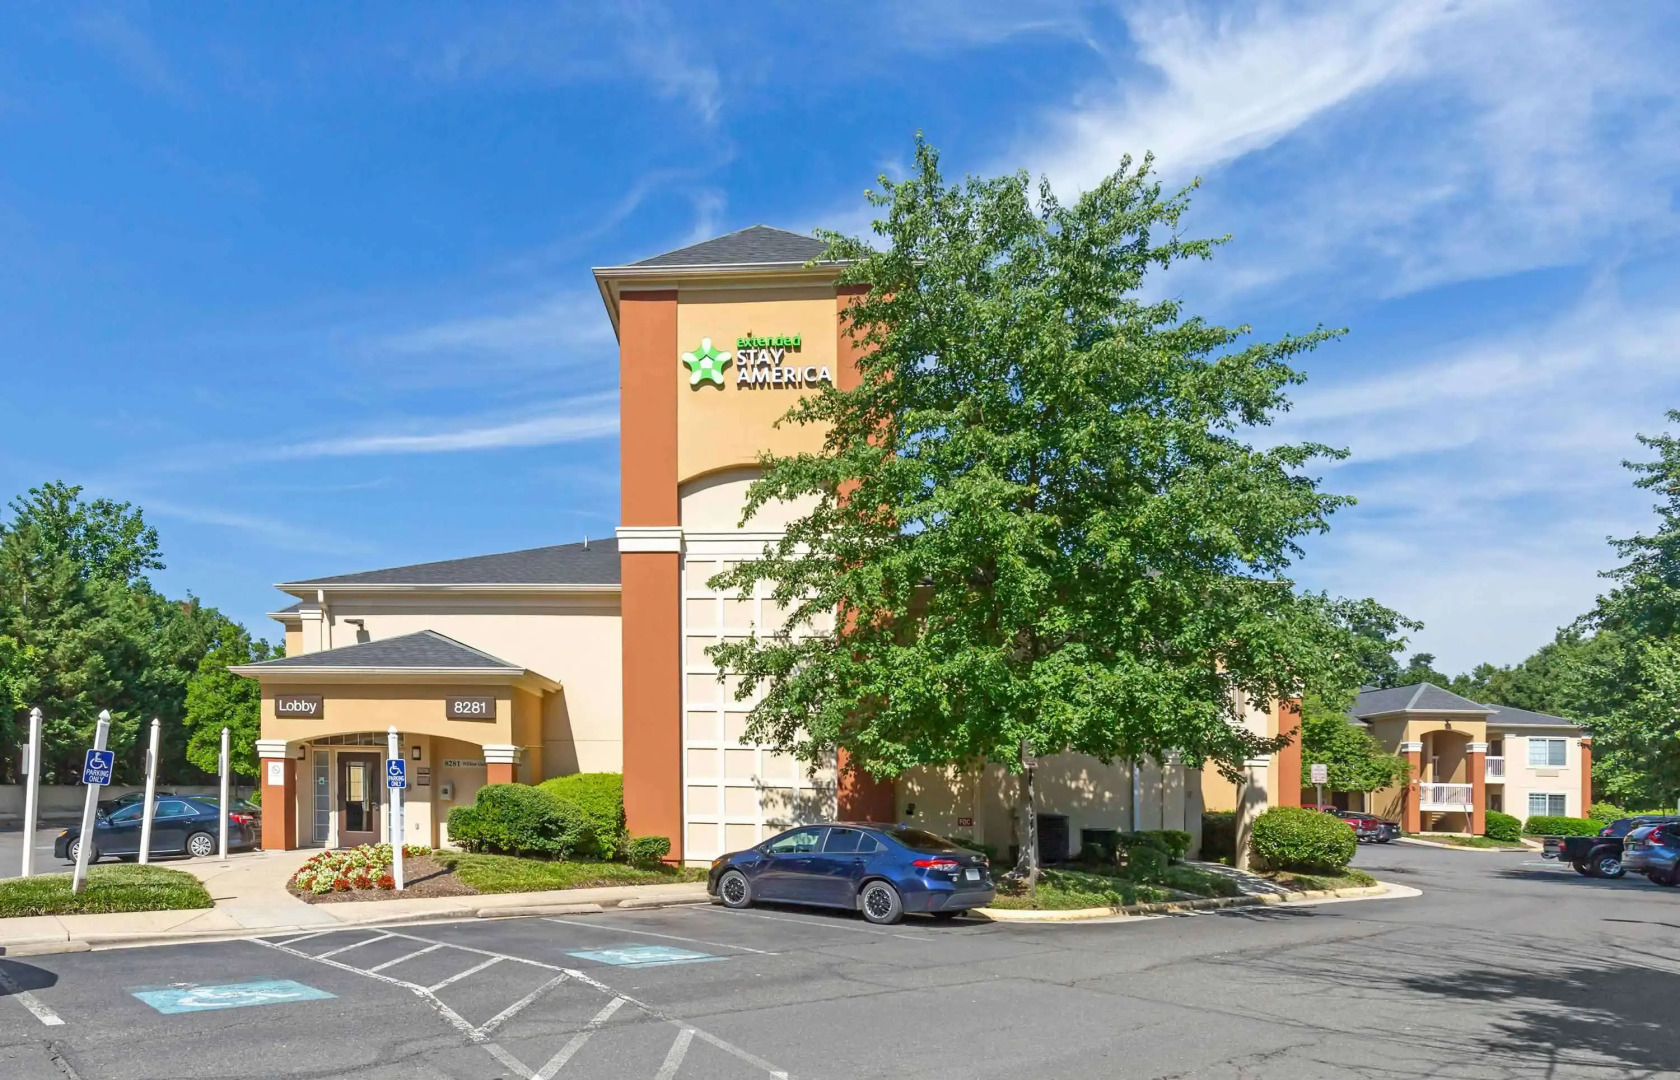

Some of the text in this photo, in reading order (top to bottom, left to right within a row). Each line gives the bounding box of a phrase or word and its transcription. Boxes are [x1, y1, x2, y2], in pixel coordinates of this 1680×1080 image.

[736, 333, 801, 348] extended
[736, 348, 784, 366] STAY
[736, 366, 832, 383] AMERICA
[279, 699, 317, 714] Lobby
[454, 701, 486, 714] 8281
[86, 769, 109, 778] PARKING
